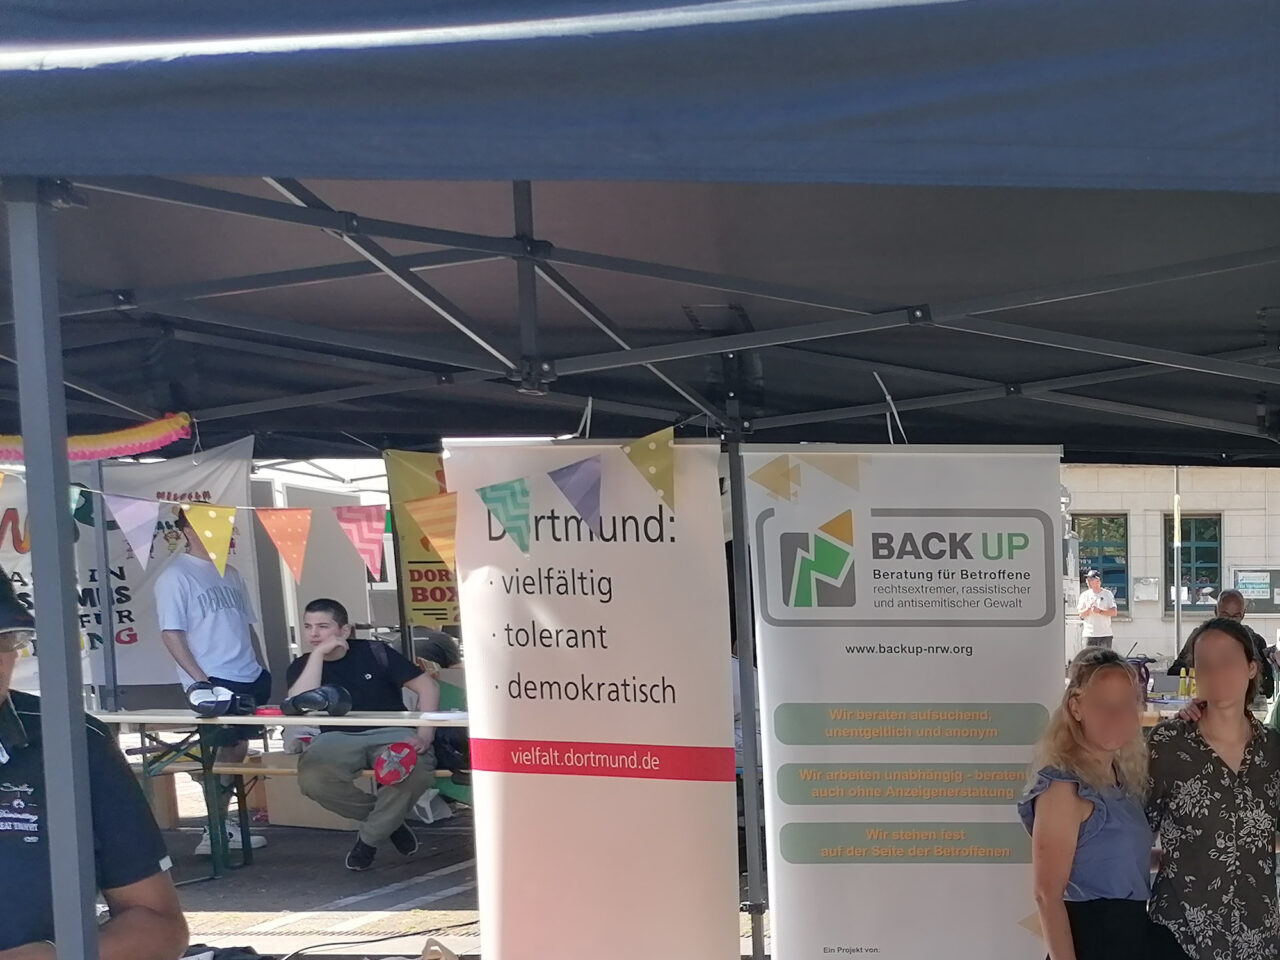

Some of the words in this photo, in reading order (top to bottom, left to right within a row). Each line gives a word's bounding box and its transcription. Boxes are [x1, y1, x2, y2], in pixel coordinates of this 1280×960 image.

[487, 504, 676, 543] Drtmund:
[871, 532, 974, 560] BACK
[981, 532, 1029, 560] UP
[408, 569, 455, 583] DOR
[872, 568, 933, 582] Beratung
[937, 569, 956, 580] für
[960, 568, 1031, 580] Betroffene
[502, 567, 612, 603] vielfältig
[873, 583, 959, 597] rechtsextremer,
[961, 583, 1031, 595] rassistischer
[873, 597, 894, 608] und
[897, 597, 979, 608] antisemitischer
[983, 597, 1022, 608] Gewalt
[504, 620, 608, 650] tolerant
[845, 643, 973, 656] www.backup-nrw.org
[508, 672, 676, 704] demokratisch
[828, 709, 854, 721] Wir
[857, 709, 907, 721] beraten
[910, 709, 992, 722] aufsuchend,
[824, 725, 913, 739] unentgeltlich
[916, 725, 942, 737] und
[945, 727, 998, 740] anonym
[511, 747, 660, 770] vielfalt.dortmund.de
[799, 769, 825, 781] Wir
[826, 769, 881, 781] arbeiten
[883, 769, 963, 783] unabhängig
[975, 769, 1026, 781] beraten
[811, 786, 847, 798] auch
[849, 786, 883, 798] ohne
[886, 786, 1014, 800] Anzeigenerstattung
[866, 829, 890, 840] Wir
[892, 829, 936, 840] stehen
[938, 829, 966, 840] fest
[821, 846, 842, 857] auf
[845, 846, 869, 857] der
[871, 846, 904, 857] Seite
[908, 846, 931, 857] der
[934, 846, 1010, 857] Betroffenen
[837, 946, 863, 955] Projekt
